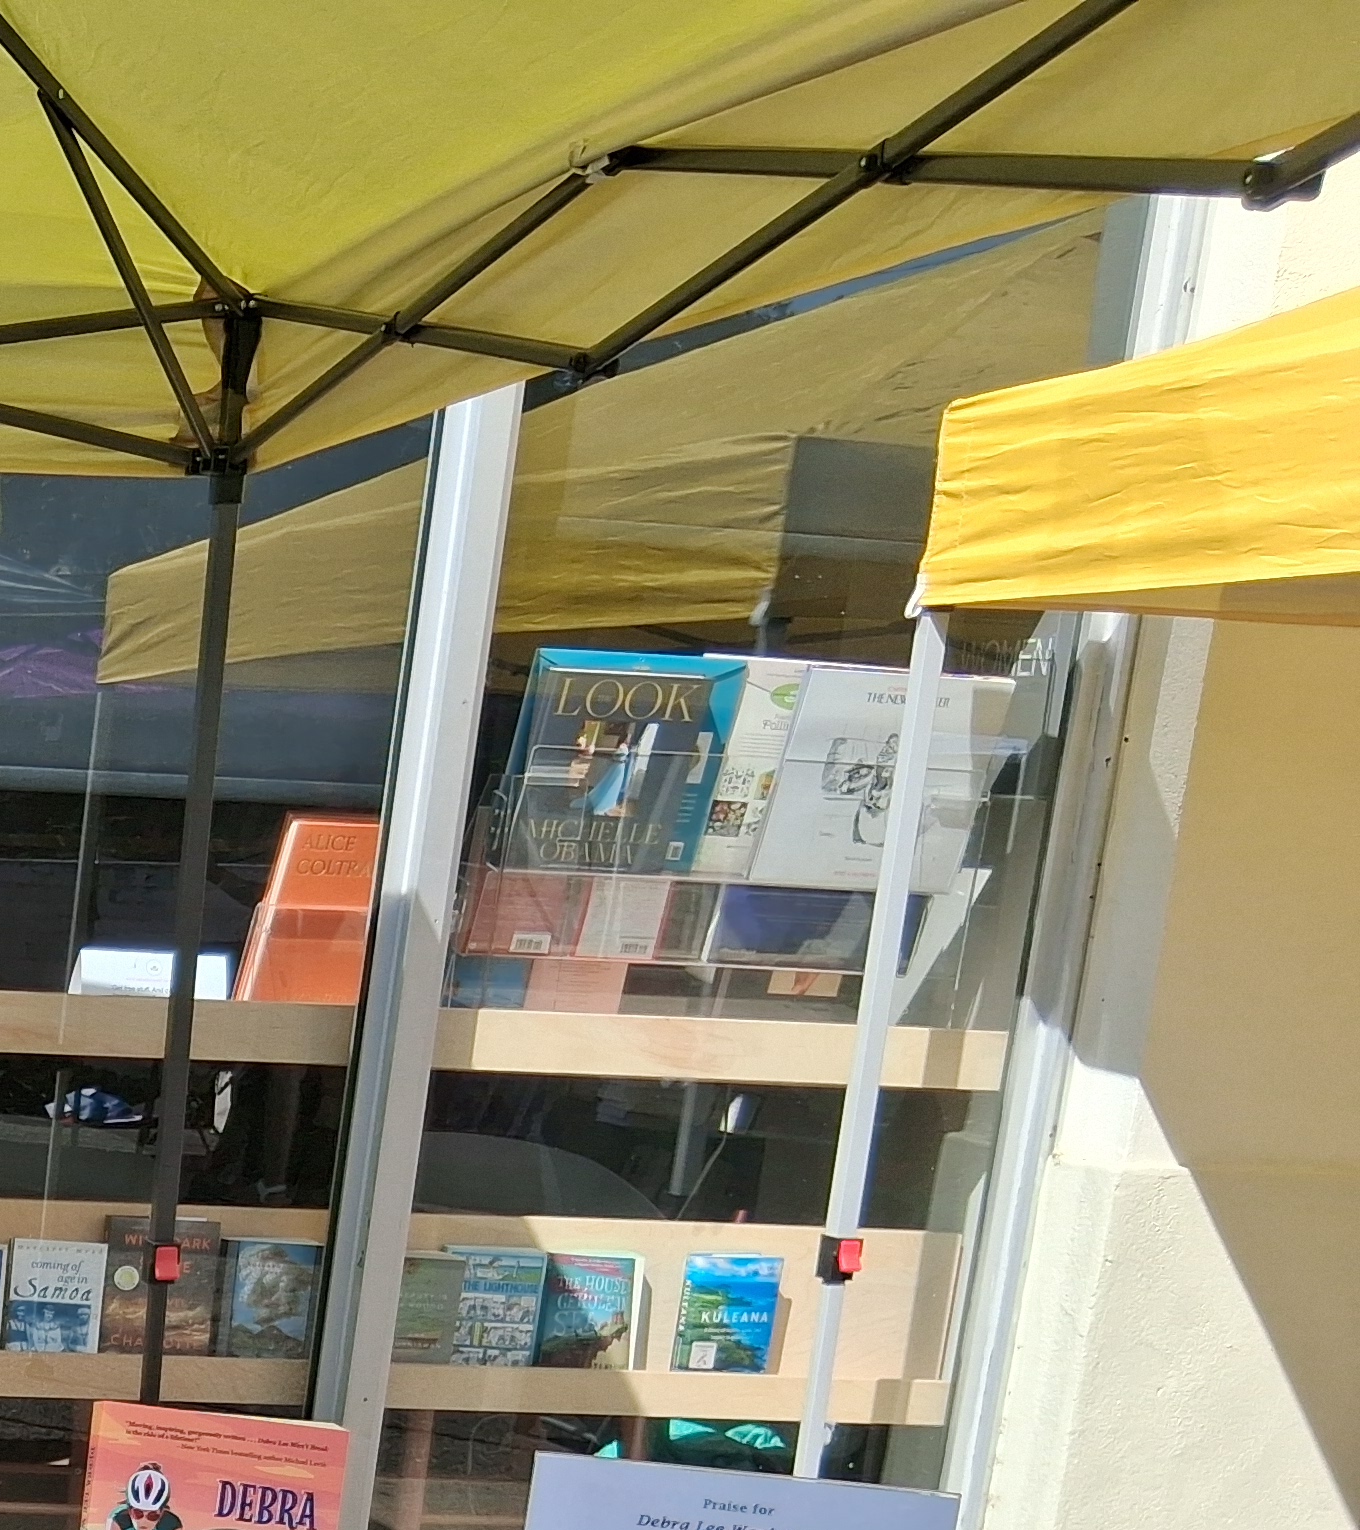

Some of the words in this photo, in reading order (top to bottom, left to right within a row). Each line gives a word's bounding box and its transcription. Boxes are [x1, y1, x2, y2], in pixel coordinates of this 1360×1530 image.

[554, 678, 701, 722] LOOK
[303, 835, 357, 851] ALICE
[30, 1261, 70, 1274] coming
[71, 1260, 82, 1275] of
[57, 1273, 77, 1287] age
[76, 1274, 88, 1284] in
[462, 1280, 481, 1291] THE
[483, 1282, 540, 1294] LIGHTHOUSE
[585, 1275, 628, 1294] HOUSE
[13, 1278, 92, 1301] Samoa
[700, 1311, 768, 1323] KULEANA
[703, 1498, 748, 1515] Praise
[751, 1503, 775, 1517] for
